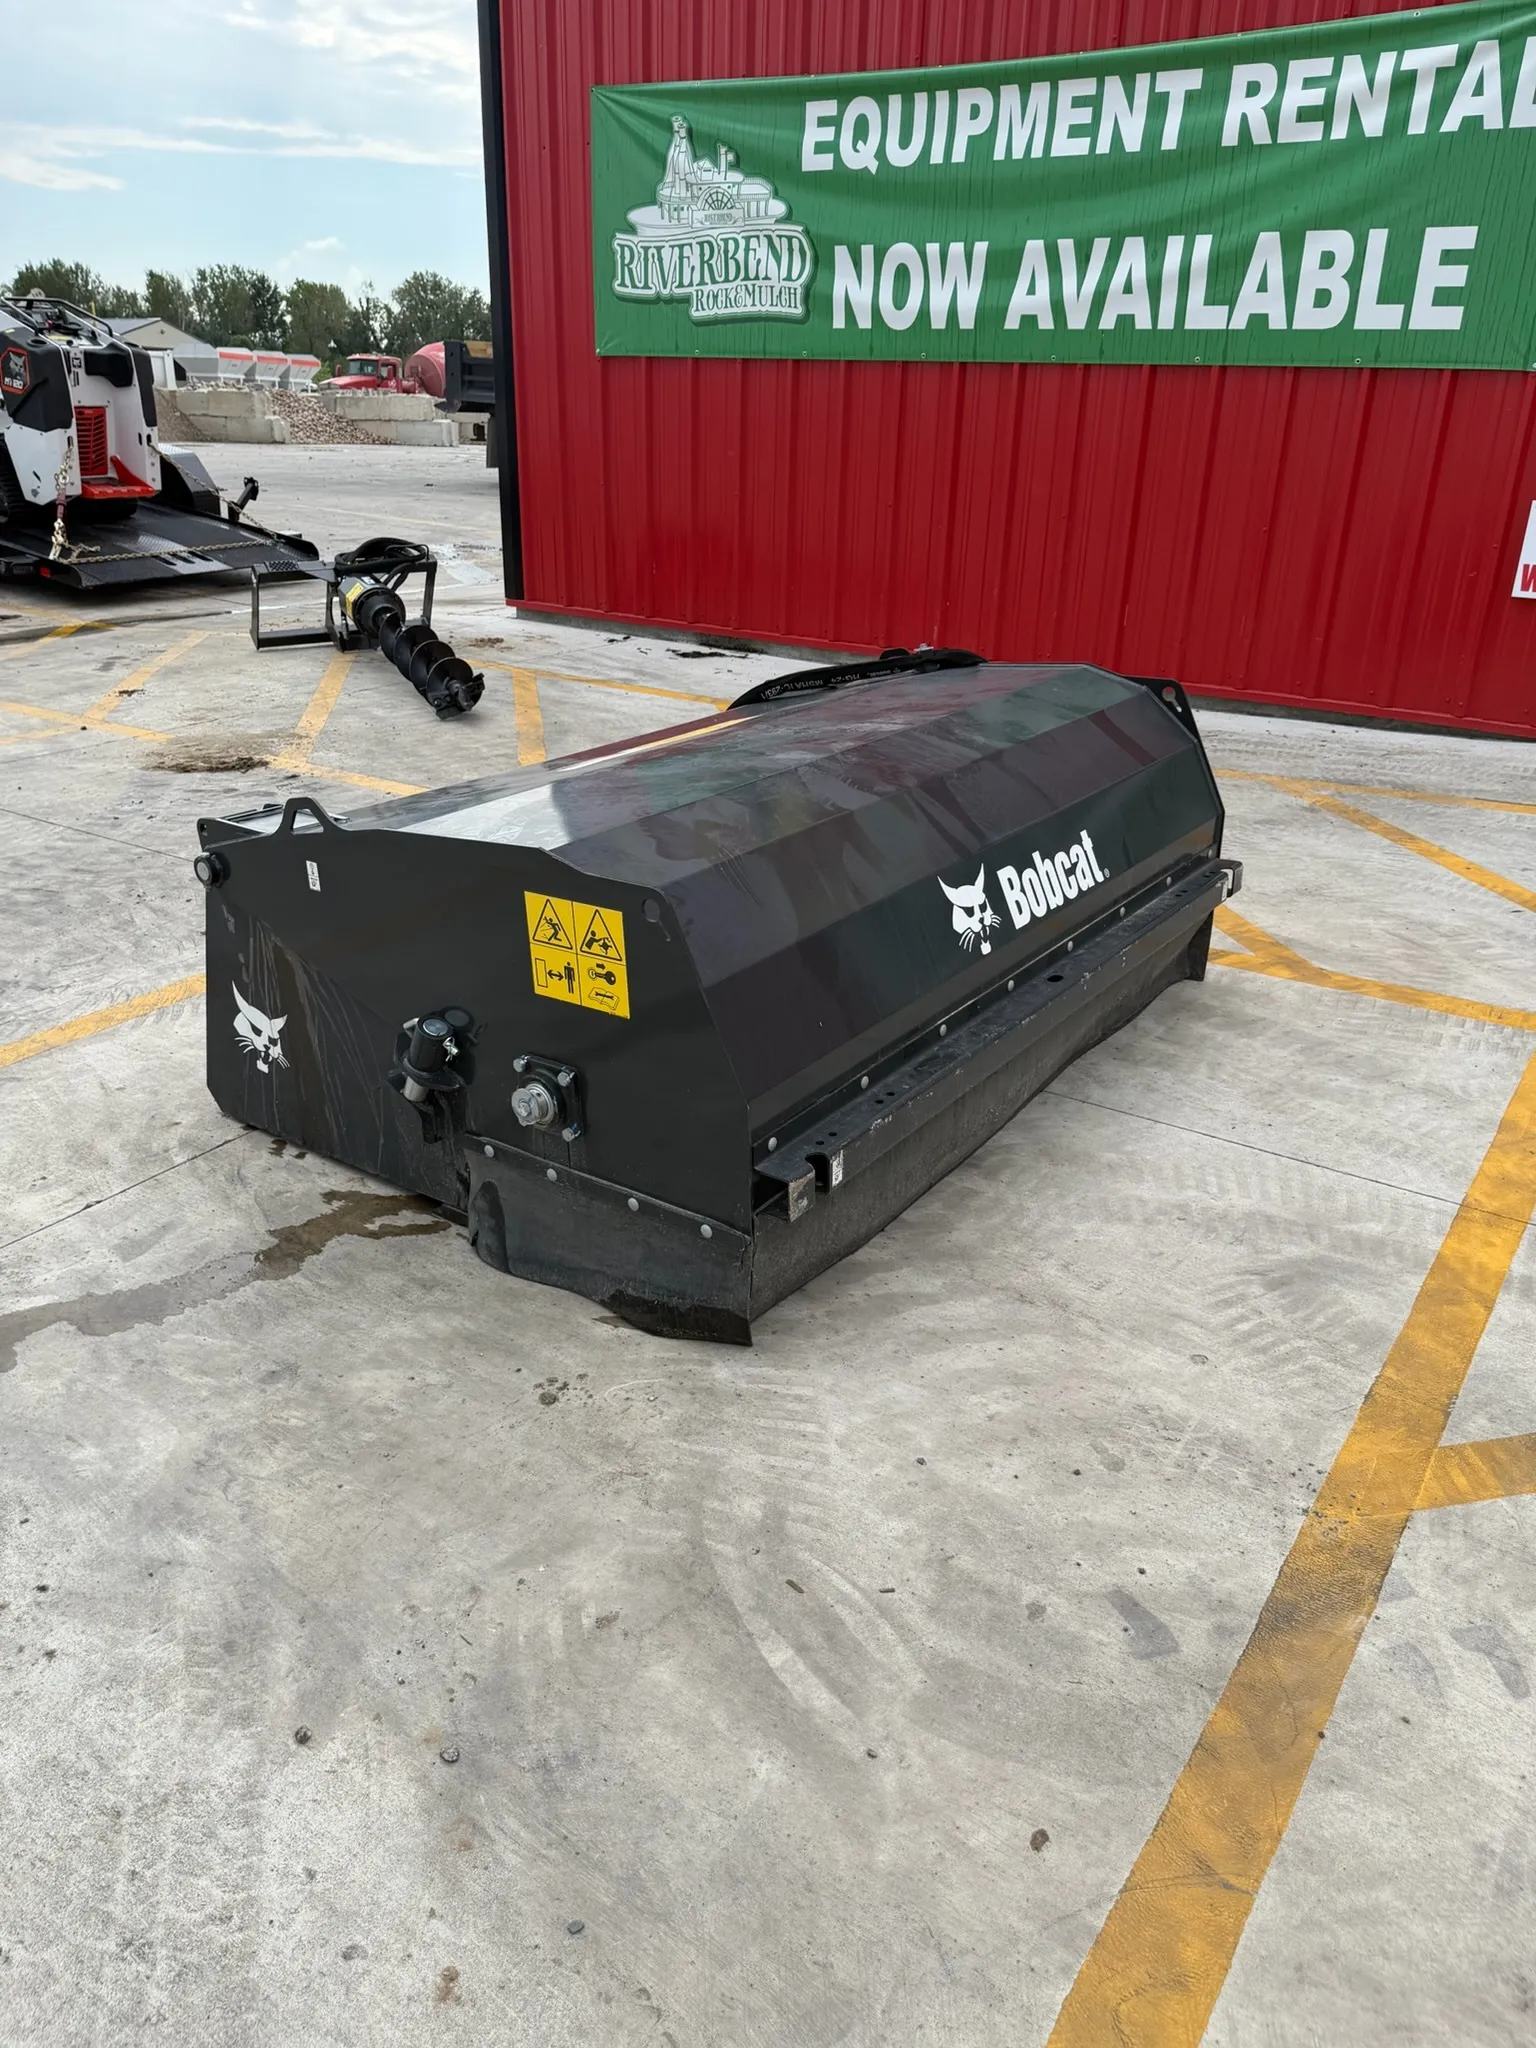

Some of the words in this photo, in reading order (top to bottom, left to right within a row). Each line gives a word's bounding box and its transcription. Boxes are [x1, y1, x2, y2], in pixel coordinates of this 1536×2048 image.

[802, 68, 1203, 175] EQUIPMENT
[617, 234, 806, 290] RIVERBEND
[833, 241, 988, 330] NOW
[1004, 226, 1479, 330] AVAILABLE
[996, 829, 1105, 930] Bobcat
